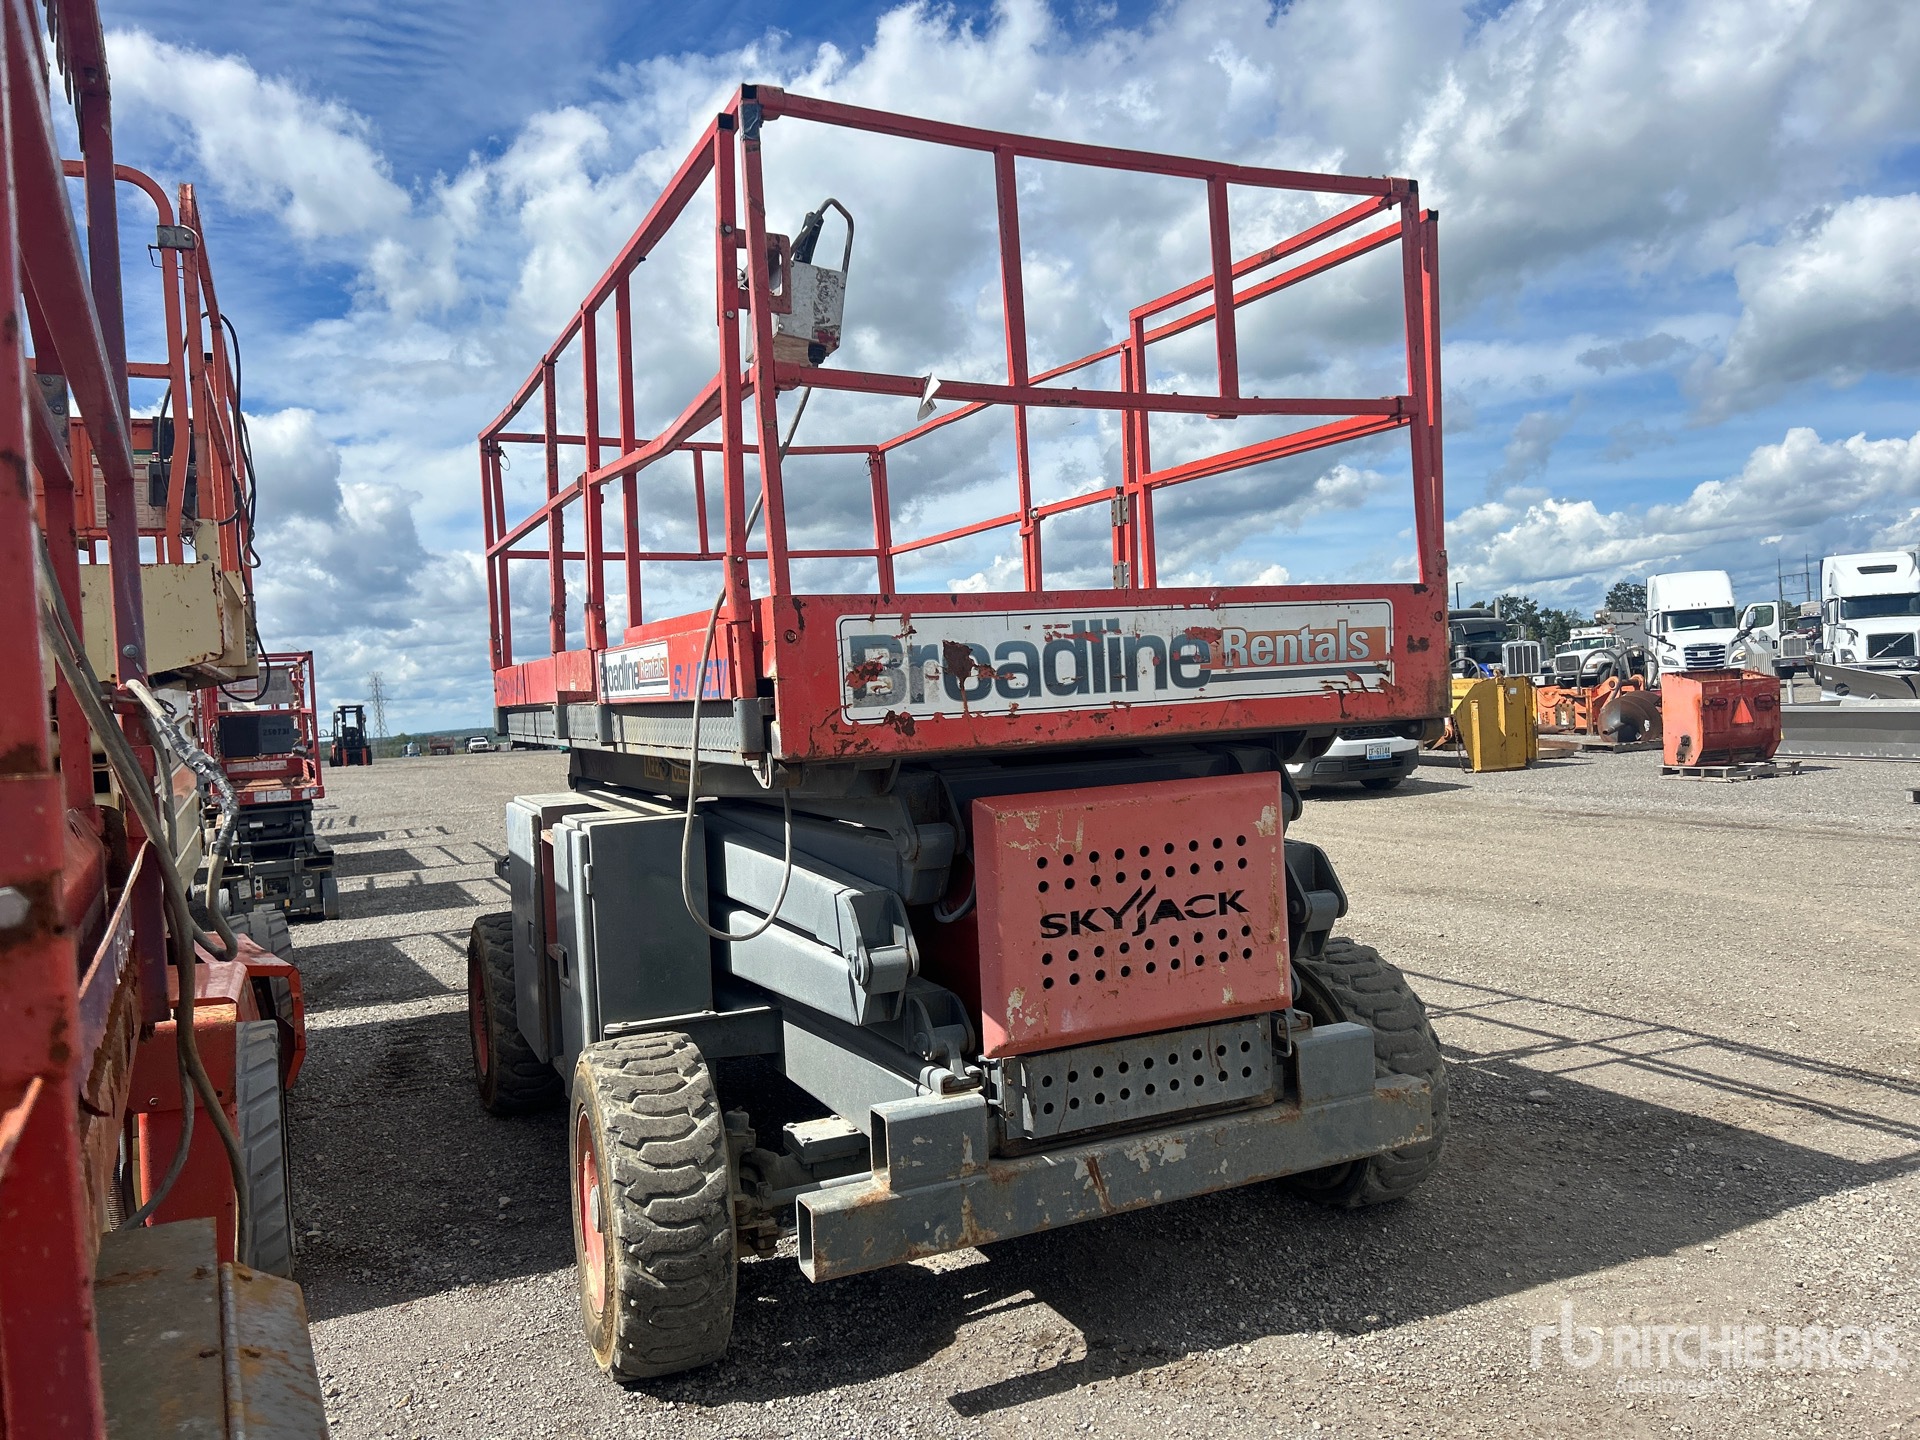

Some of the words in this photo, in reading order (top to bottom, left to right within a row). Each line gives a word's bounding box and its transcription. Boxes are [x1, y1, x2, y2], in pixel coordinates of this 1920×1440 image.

[600, 654, 640, 692] Broadline
[640, 653, 665, 679] Rentals
[673, 663, 691, 700] SJ
[849, 619, 1212, 708] Broadline
[1221, 619, 1370, 667] Rentals
[1039, 884, 1250, 939] SKYJACK
